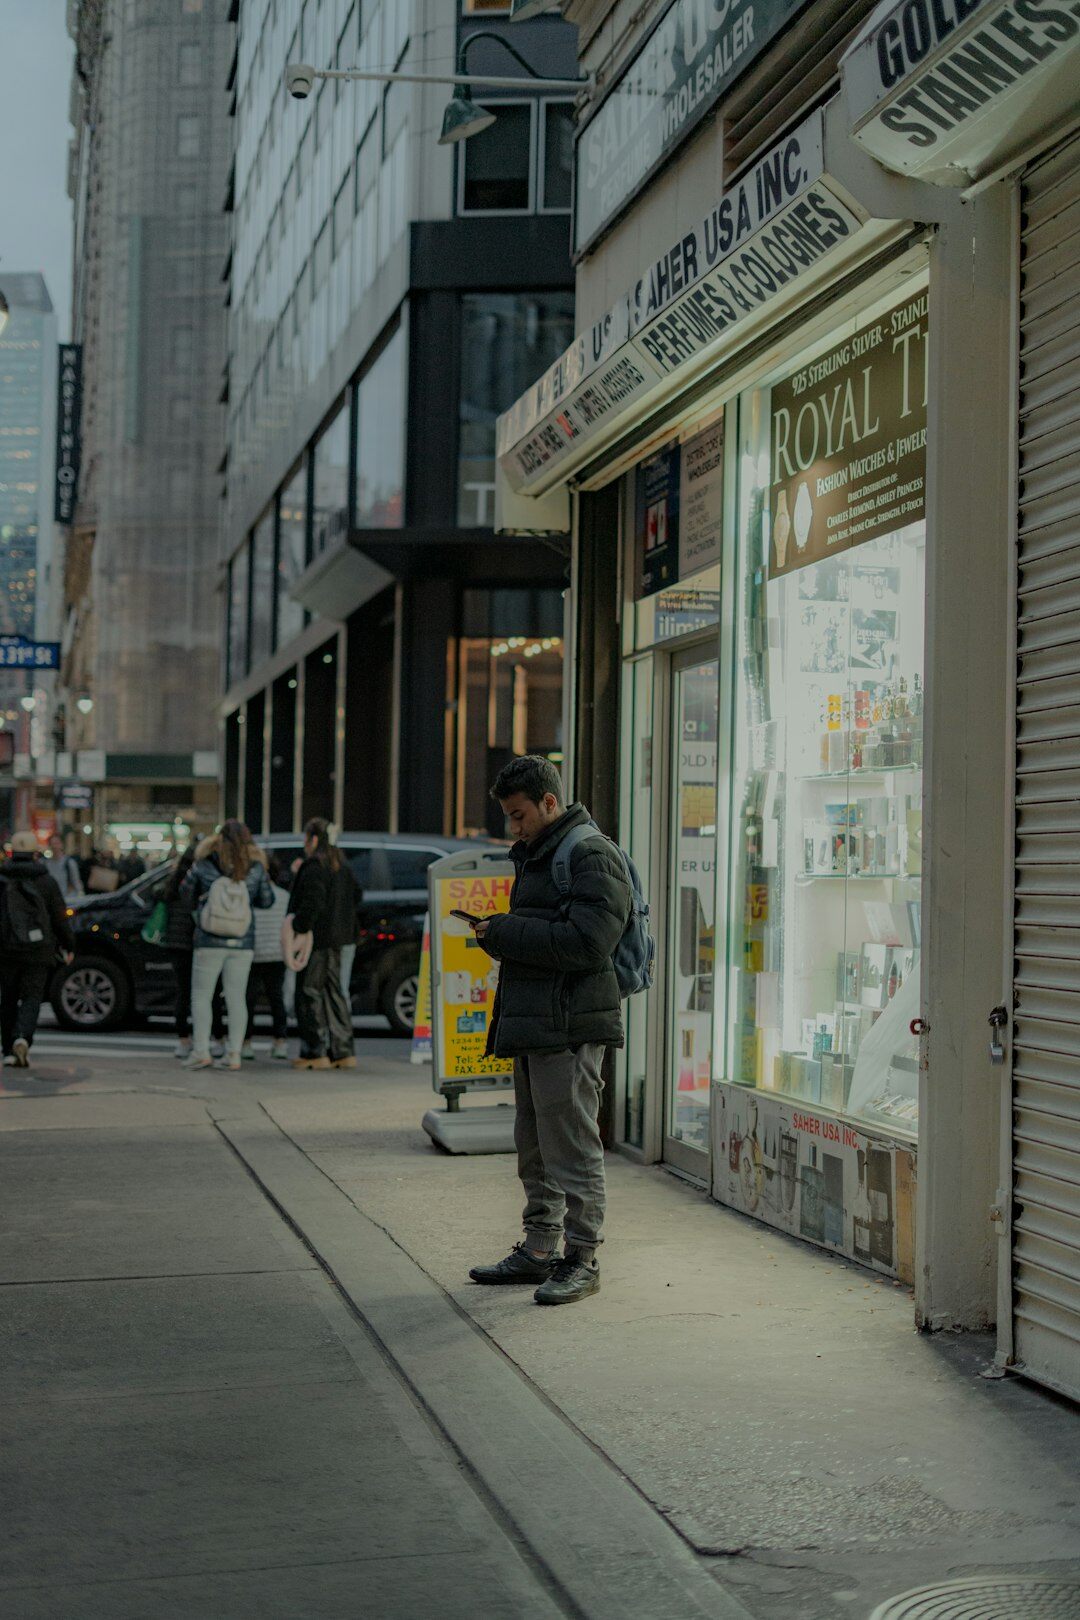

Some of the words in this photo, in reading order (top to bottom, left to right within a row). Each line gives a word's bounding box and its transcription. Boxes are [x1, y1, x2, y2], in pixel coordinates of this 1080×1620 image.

[659, 5, 755, 142] WHOLESALER
[880, 0, 1080, 147] STAINLES
[634, 232, 698, 326] SAHER
[704, 185, 751, 265] USA
[756, 137, 808, 222] INC.
[730, 192, 849, 302] COLOGNES
[641, 282, 738, 372] PERFUMES
[717, 274, 754, 312] &
[792, 371, 808, 397] 925
[808, 346, 850, 388] STERLING
[852, 325, 883, 360] SILVER
[891, 293, 929, 335] STAINL
[773, 366, 880, 485] ROYAL
[816, 467, 848, 497] FASHION
[849, 448, 886, 480] WATCHES
[887, 442, 894, 463] &
[35, 646, 52, 665] St
[457, 899, 497, 912] USA
[455, 1065, 476, 1074] FAX:
[793, 1113, 820, 1136] SAHER
[822, 1121, 840, 1143] USA
[842, 1127, 860, 1149] INC.
